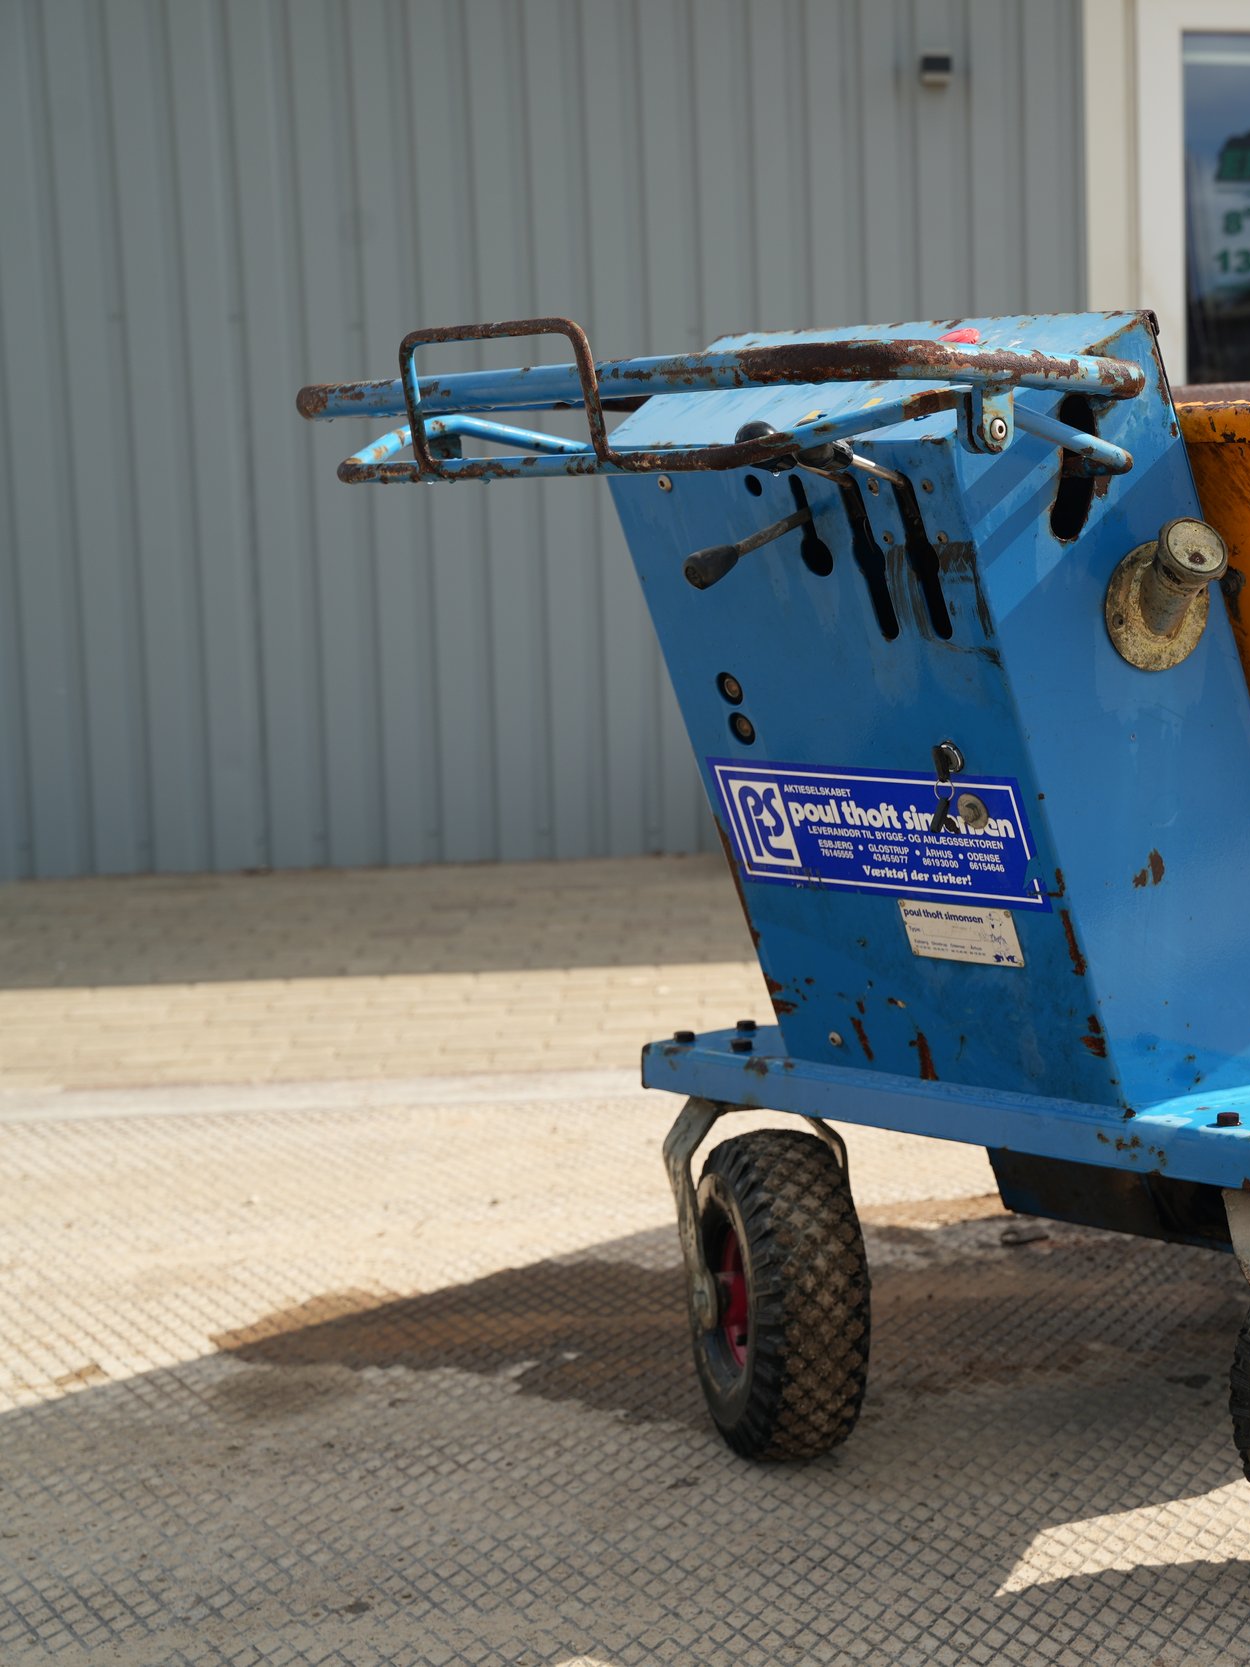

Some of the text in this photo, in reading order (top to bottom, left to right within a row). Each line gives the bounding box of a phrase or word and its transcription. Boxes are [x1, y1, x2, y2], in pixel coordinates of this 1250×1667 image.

[784, 784, 851, 797] AKTIESELSKABET
[788, 799, 841, 827] poul
[841, 800, 901, 829] thoft
[808, 825, 1004, 850] LEVERANDØR TIL BYGGE- OG ANLÆGSSEKTOREN
[818, 839, 854, 851] ESBJERG
[868, 843, 910, 856] GLOSTRUP
[967, 852, 1001, 863] ODENSE
[862, 865, 972, 886] Værktøj der virker!
[903, 908, 984, 924] poul thoft simonsen
